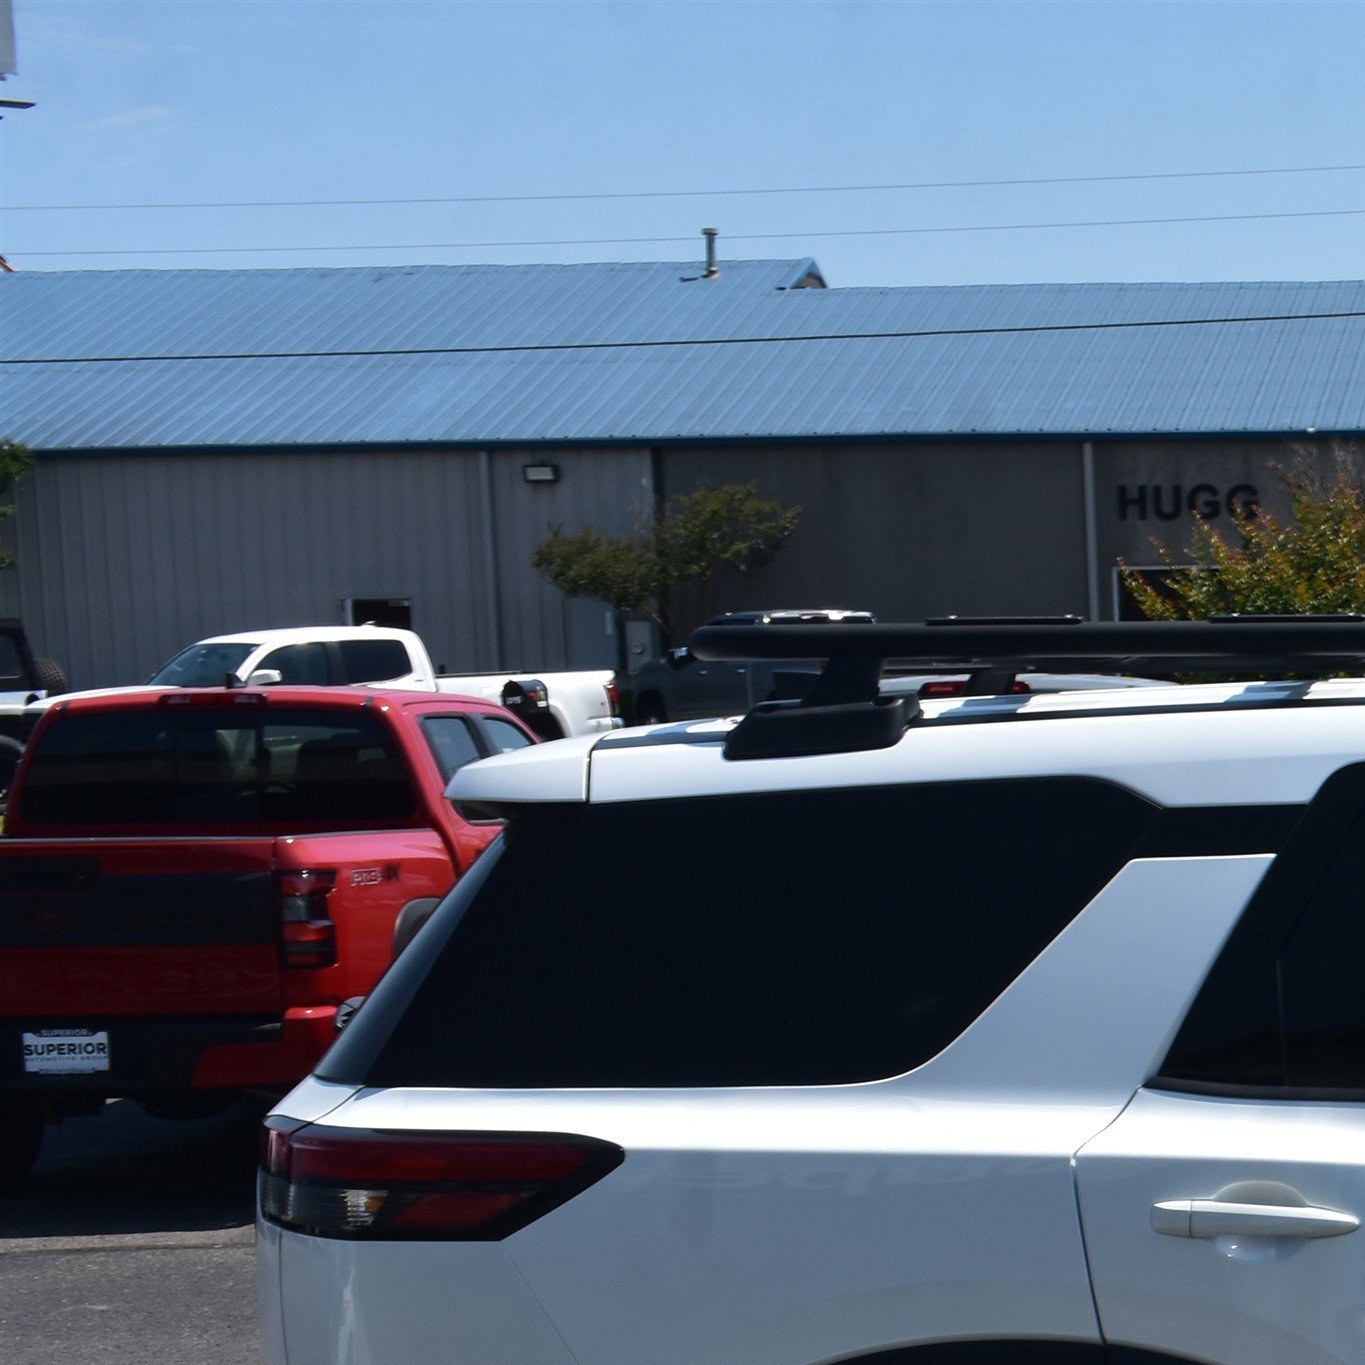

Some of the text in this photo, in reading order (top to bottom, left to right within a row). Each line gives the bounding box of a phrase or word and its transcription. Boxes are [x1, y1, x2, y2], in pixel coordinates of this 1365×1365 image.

[1117, 483, 1262, 522] HUGG
[40, 1028, 88, 1037] SUPERIOR
[24, 1042, 107, 1056] SUPERIOR
